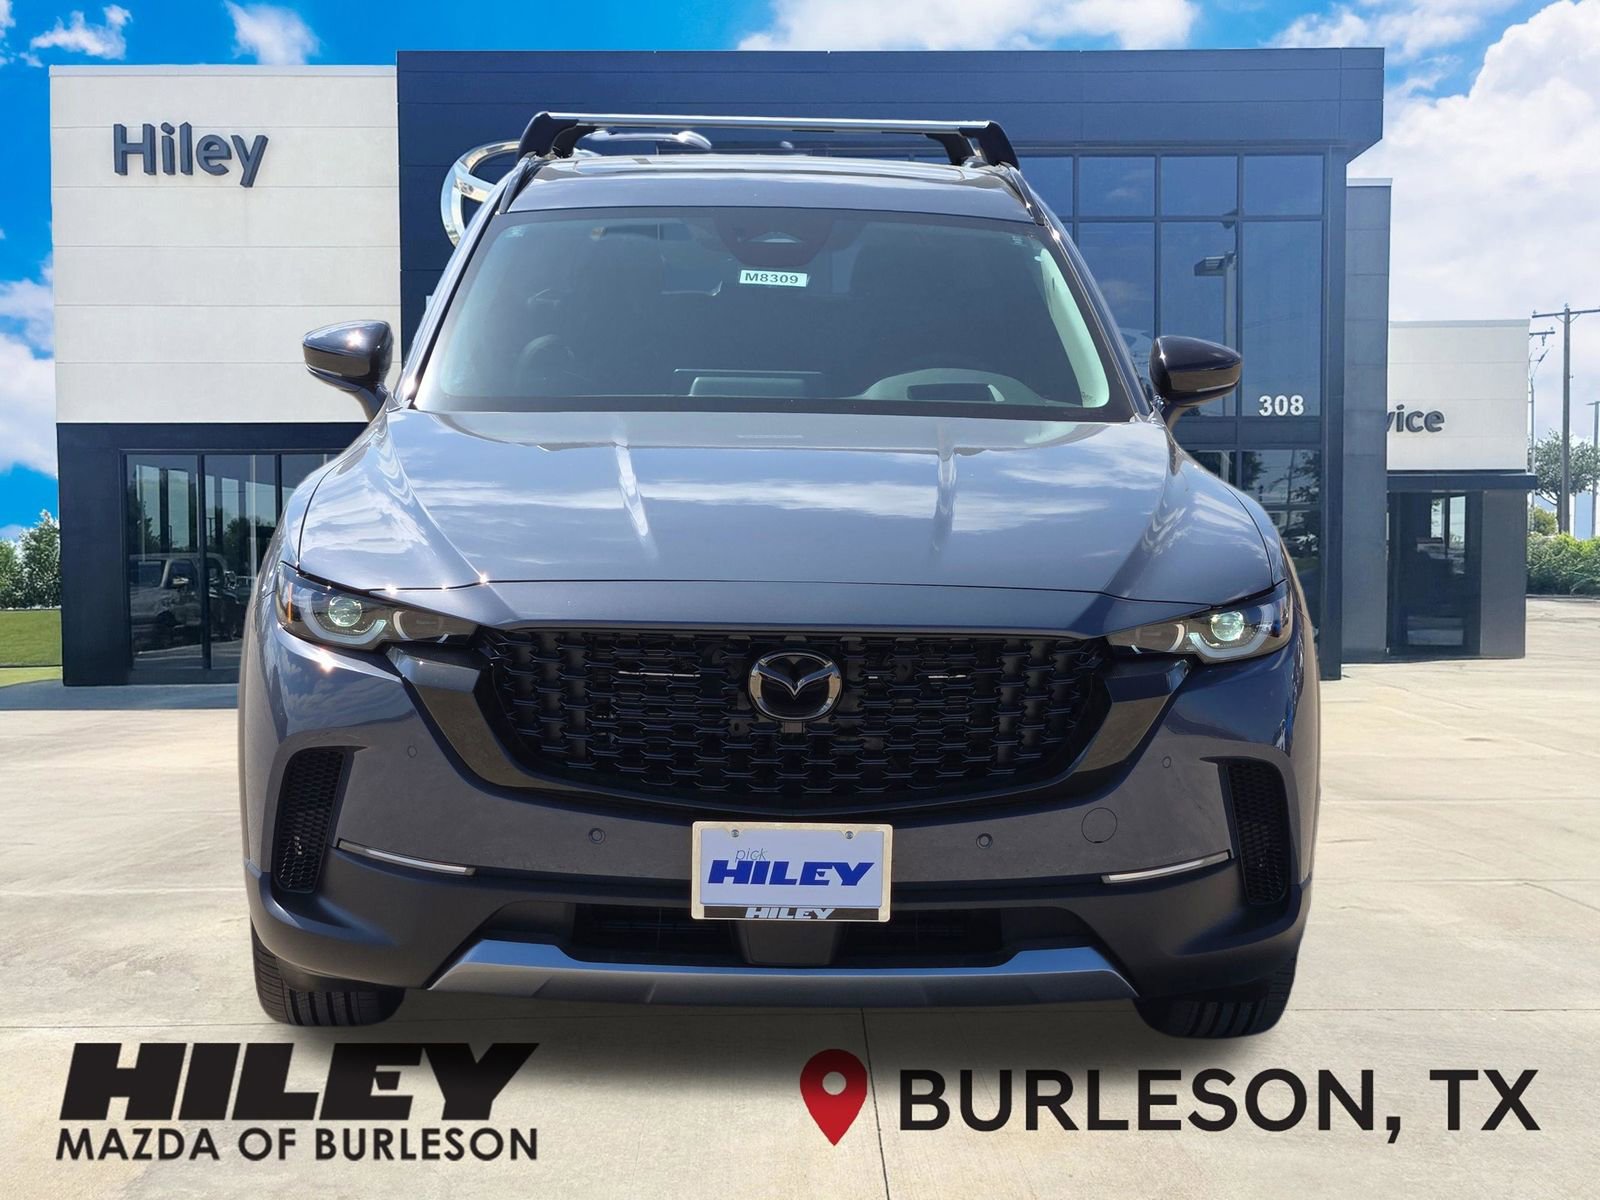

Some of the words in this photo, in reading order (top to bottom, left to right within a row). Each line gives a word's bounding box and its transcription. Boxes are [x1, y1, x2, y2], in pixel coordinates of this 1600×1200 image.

[113, 121, 269, 188] Hiley
[745, 272, 799, 284] M8309
[1258, 394, 1304, 416] 308
[735, 848, 767, 863] pick
[708, 860, 874, 886] HILEY
[745, 906, 836, 920] HILEY
